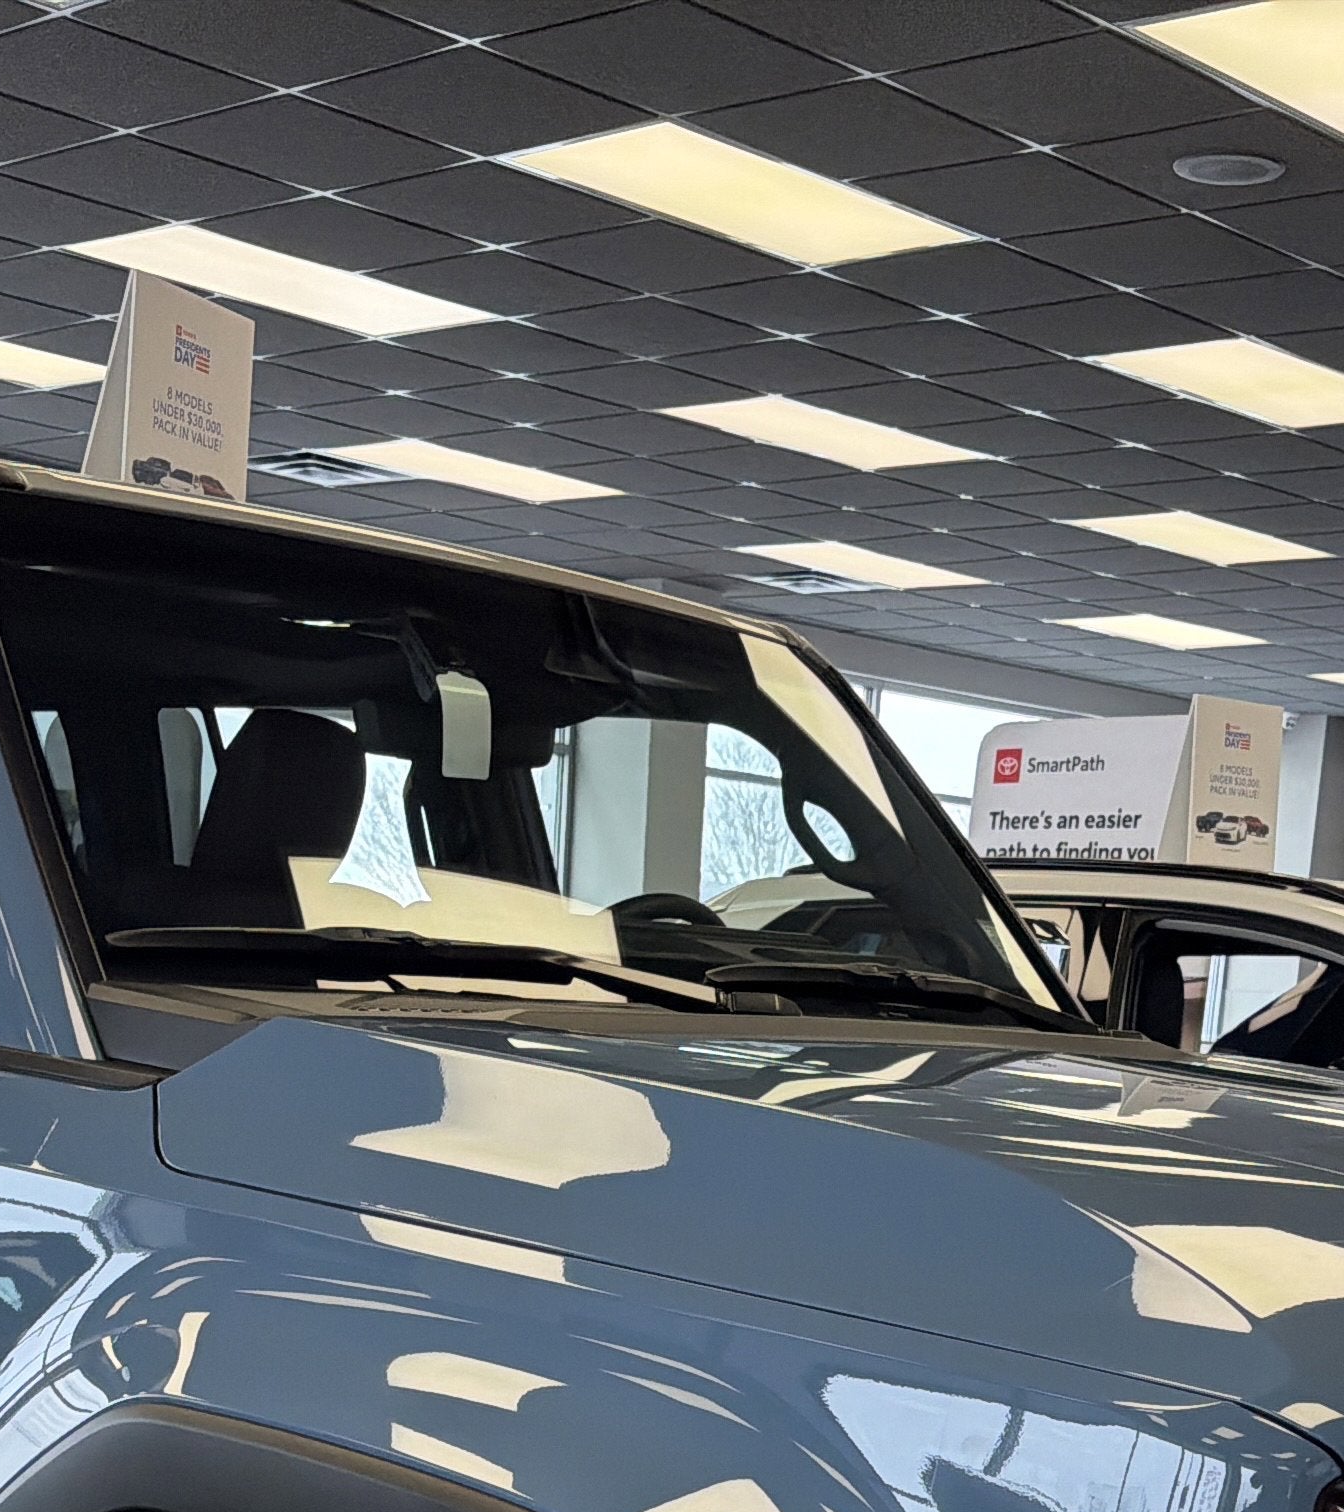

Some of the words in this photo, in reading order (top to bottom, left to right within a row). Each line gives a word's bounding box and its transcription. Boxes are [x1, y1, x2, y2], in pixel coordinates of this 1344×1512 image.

[174, 347, 196, 369] DAY
[153, 398, 185, 422] UNDER
[167, 386, 173, 400] 8
[176, 390, 213, 415] MODELS
[153, 416, 177, 437] PACK
[179, 426, 189, 441] IN
[191, 430, 222, 453] VALUE!
[1027, 755, 1105, 774] SmartPath
[989, 810, 1053, 831] There's
[1056, 813, 1080, 830] an
[1084, 808, 1142, 830] easier
